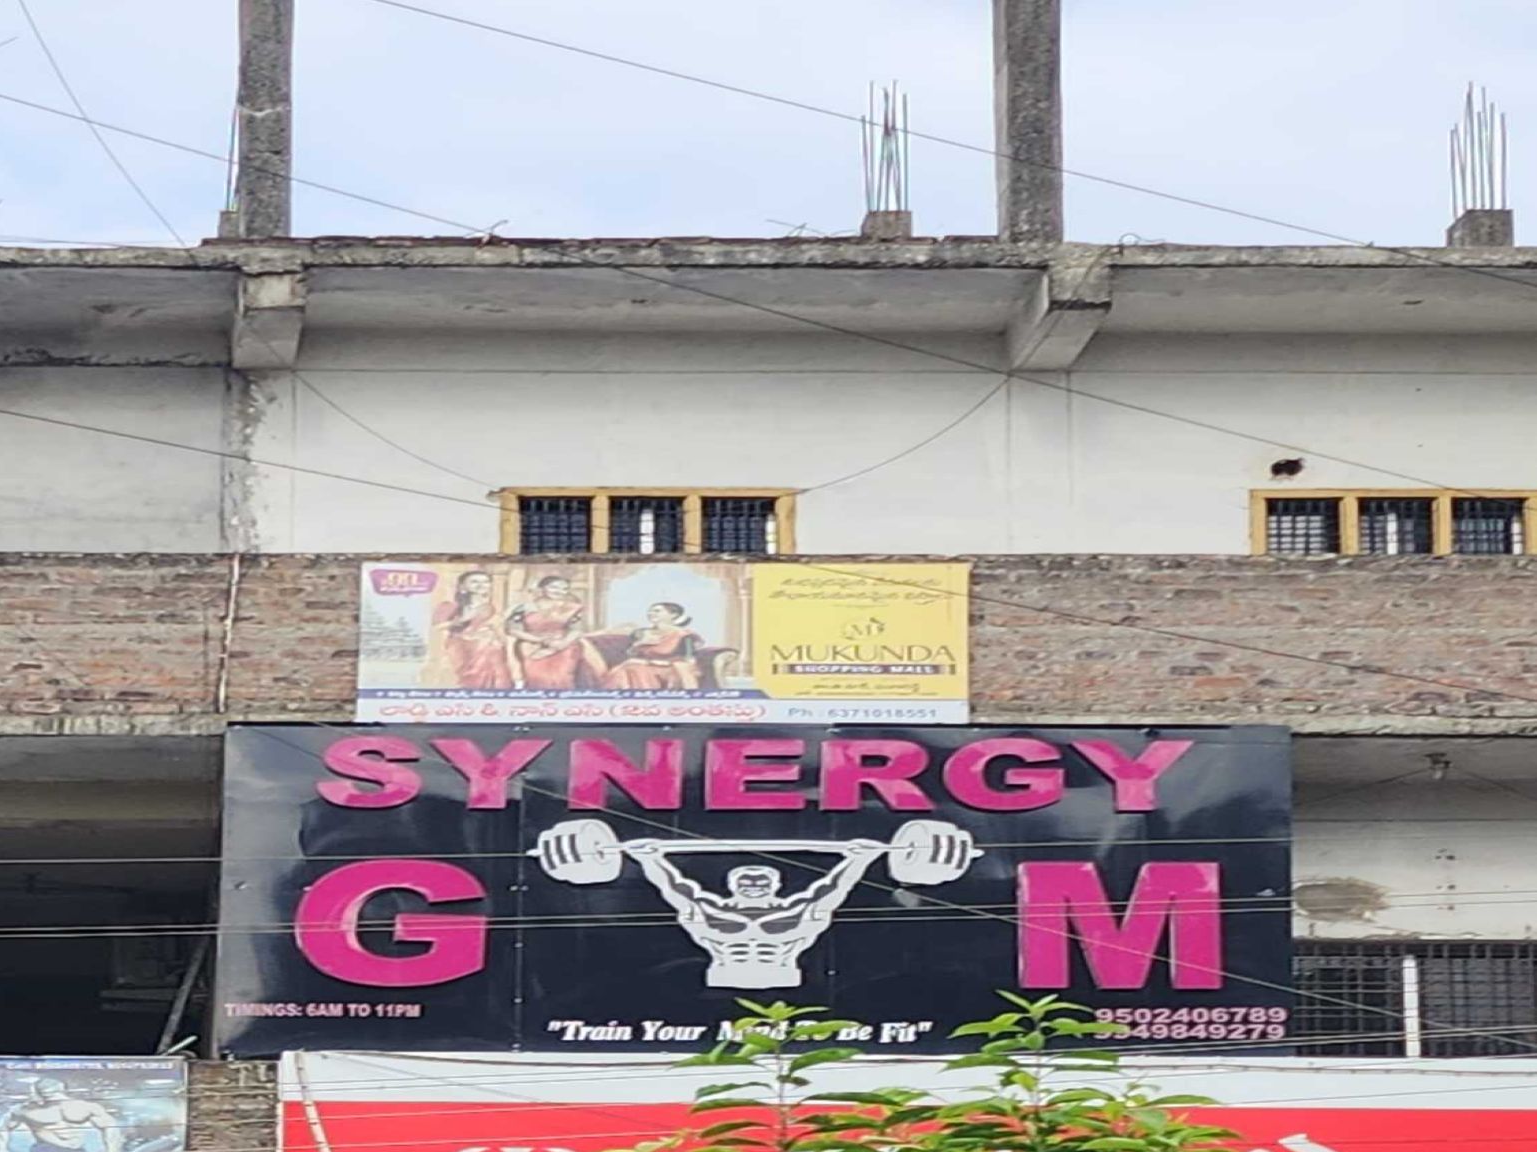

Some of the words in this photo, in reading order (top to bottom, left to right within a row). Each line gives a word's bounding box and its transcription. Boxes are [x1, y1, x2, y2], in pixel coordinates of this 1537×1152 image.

[770, 644, 956, 662] MUKUNDA
[794, 666, 883, 674] SHOPPING
[316, 734, 1195, 811] SYNERGY
[224, 1002, 303, 1018] TIMINGS:
[306, 1002, 344, 1018] 6AM
[346, 1002, 371, 1018] TO
[373, 1002, 423, 1018] 11PM
[1094, 1007, 1288, 1024] 9502406789
[640, 1020, 707, 1042] Your
